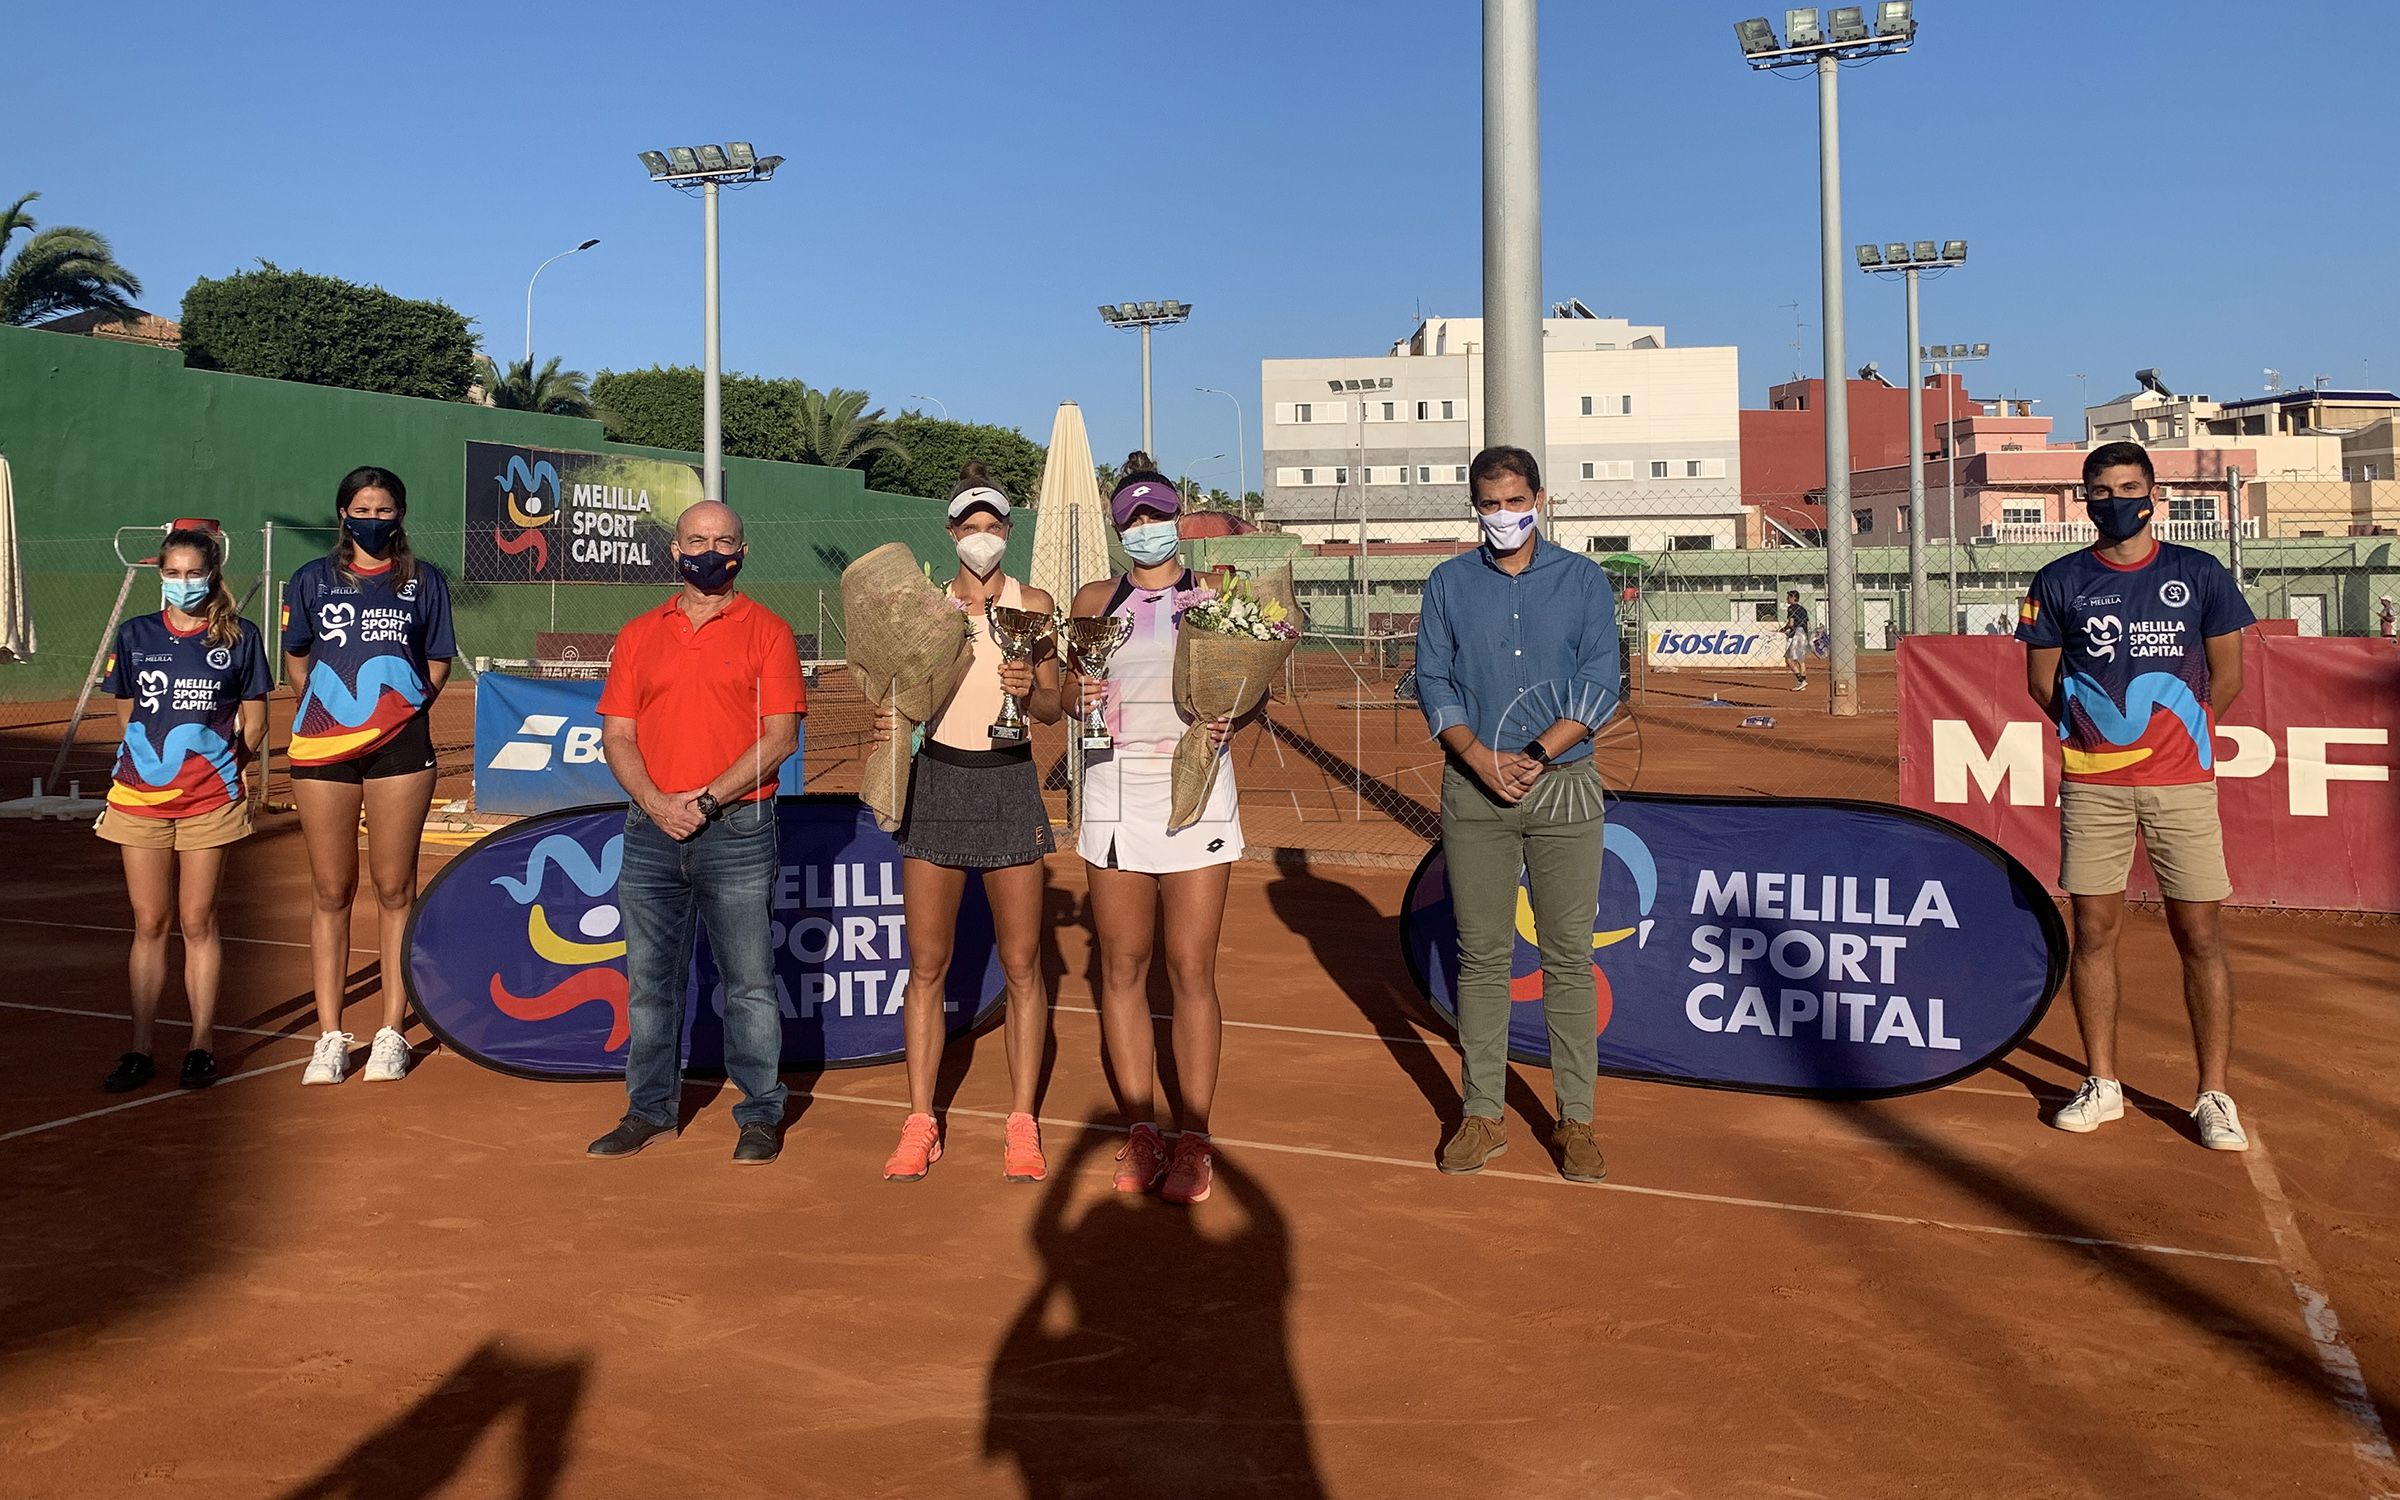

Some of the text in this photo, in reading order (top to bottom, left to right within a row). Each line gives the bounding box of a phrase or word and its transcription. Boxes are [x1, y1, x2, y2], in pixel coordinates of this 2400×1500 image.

[572, 484, 651, 512] MELILLA
[572, 512, 637, 538] SPORT
[571, 538, 651, 566] CAPITAL
[2090, 597, 2122, 607] MELILLA
[361, 608, 412, 624] MELILLA
[361, 618, 405, 631] SPORT
[2129, 621, 2186, 633] MELILLA
[1657, 629, 1760, 655] isostar
[2129, 633, 2177, 645] SPORT
[2130, 645, 2185, 657] CAPITAL
[173, 678, 222, 691] MELILLA
[172, 689, 214, 701] SPORT
[172, 700, 218, 711] CAPITAL
[1690, 869, 1960, 929] MELILLA
[1688, 924, 1907, 985] SPORT
[1685, 982, 1961, 1051] CAPITAL
